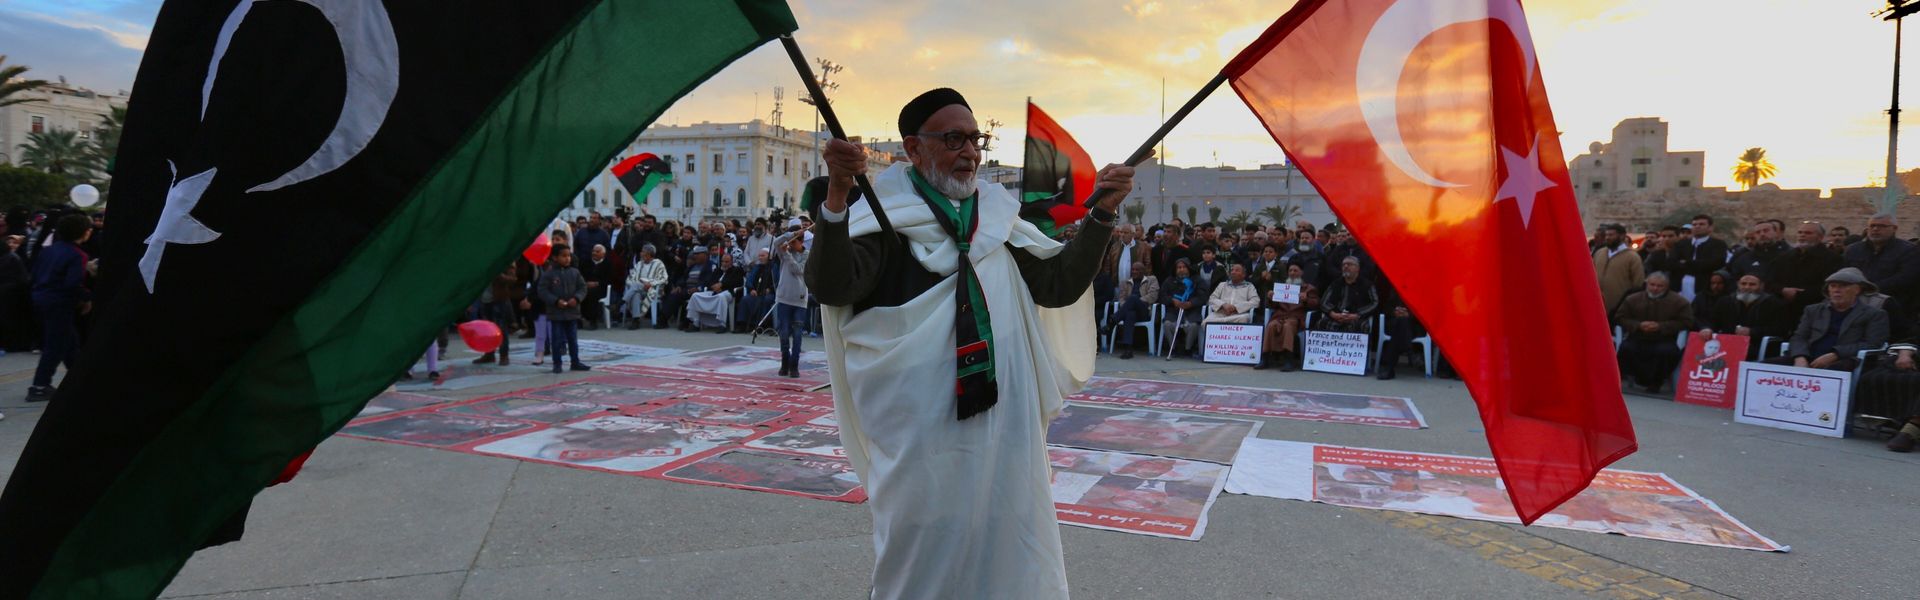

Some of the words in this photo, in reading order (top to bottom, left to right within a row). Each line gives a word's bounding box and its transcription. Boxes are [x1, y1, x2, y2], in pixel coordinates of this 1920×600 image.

[1346, 334, 1362, 342] UAE
[1321, 340, 1355, 348] partners
[1336, 348, 1364, 358] Libyan
[1141, 522, 1188, 531] ليبيا
